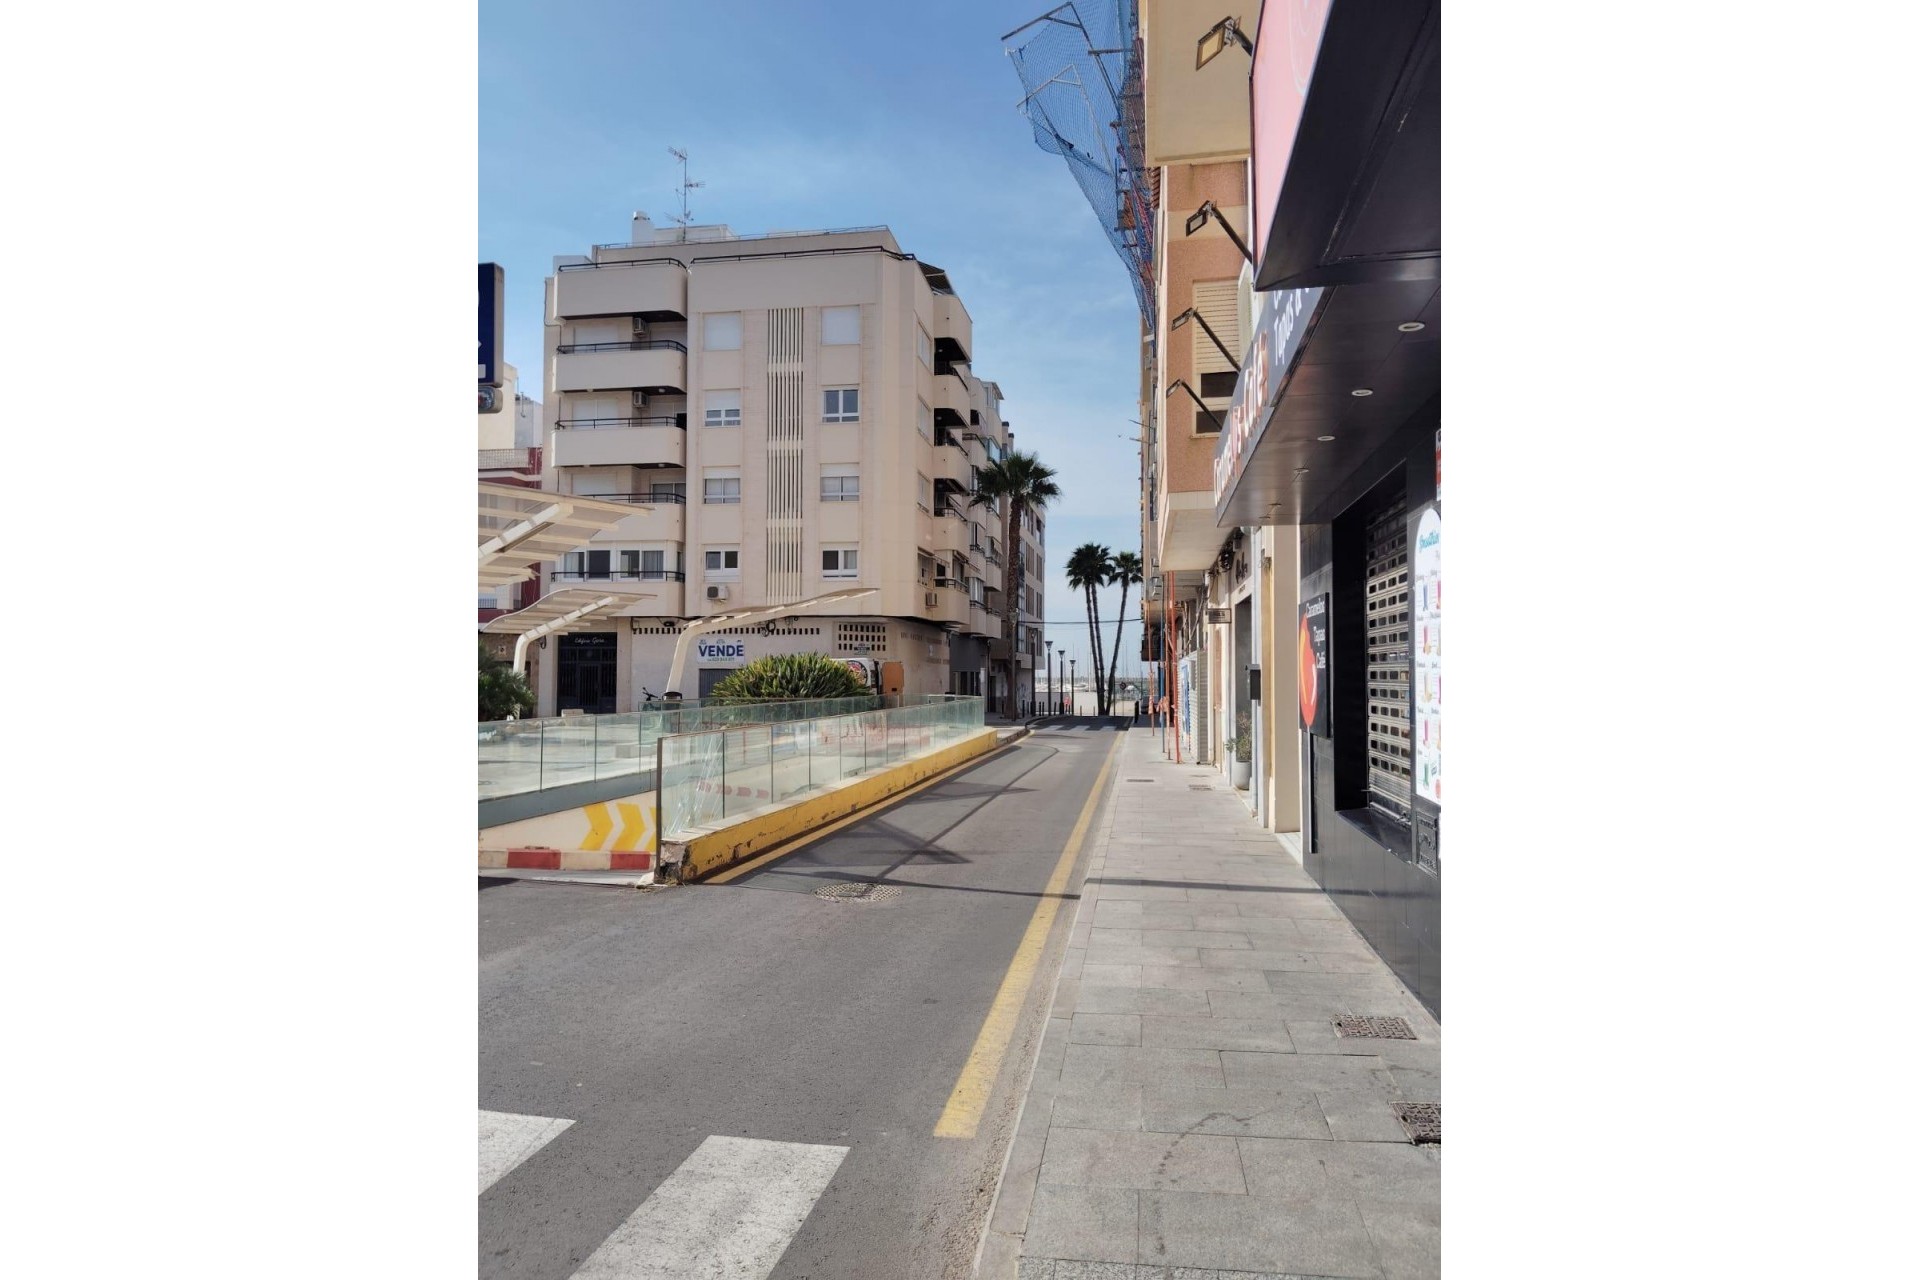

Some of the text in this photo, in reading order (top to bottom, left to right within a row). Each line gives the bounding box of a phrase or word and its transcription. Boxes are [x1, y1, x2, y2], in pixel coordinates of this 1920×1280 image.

[1273, 292, 1294, 366] Tapas
[1313, 626, 1326, 646] Tapas
[698, 645, 744, 657] VENDE
